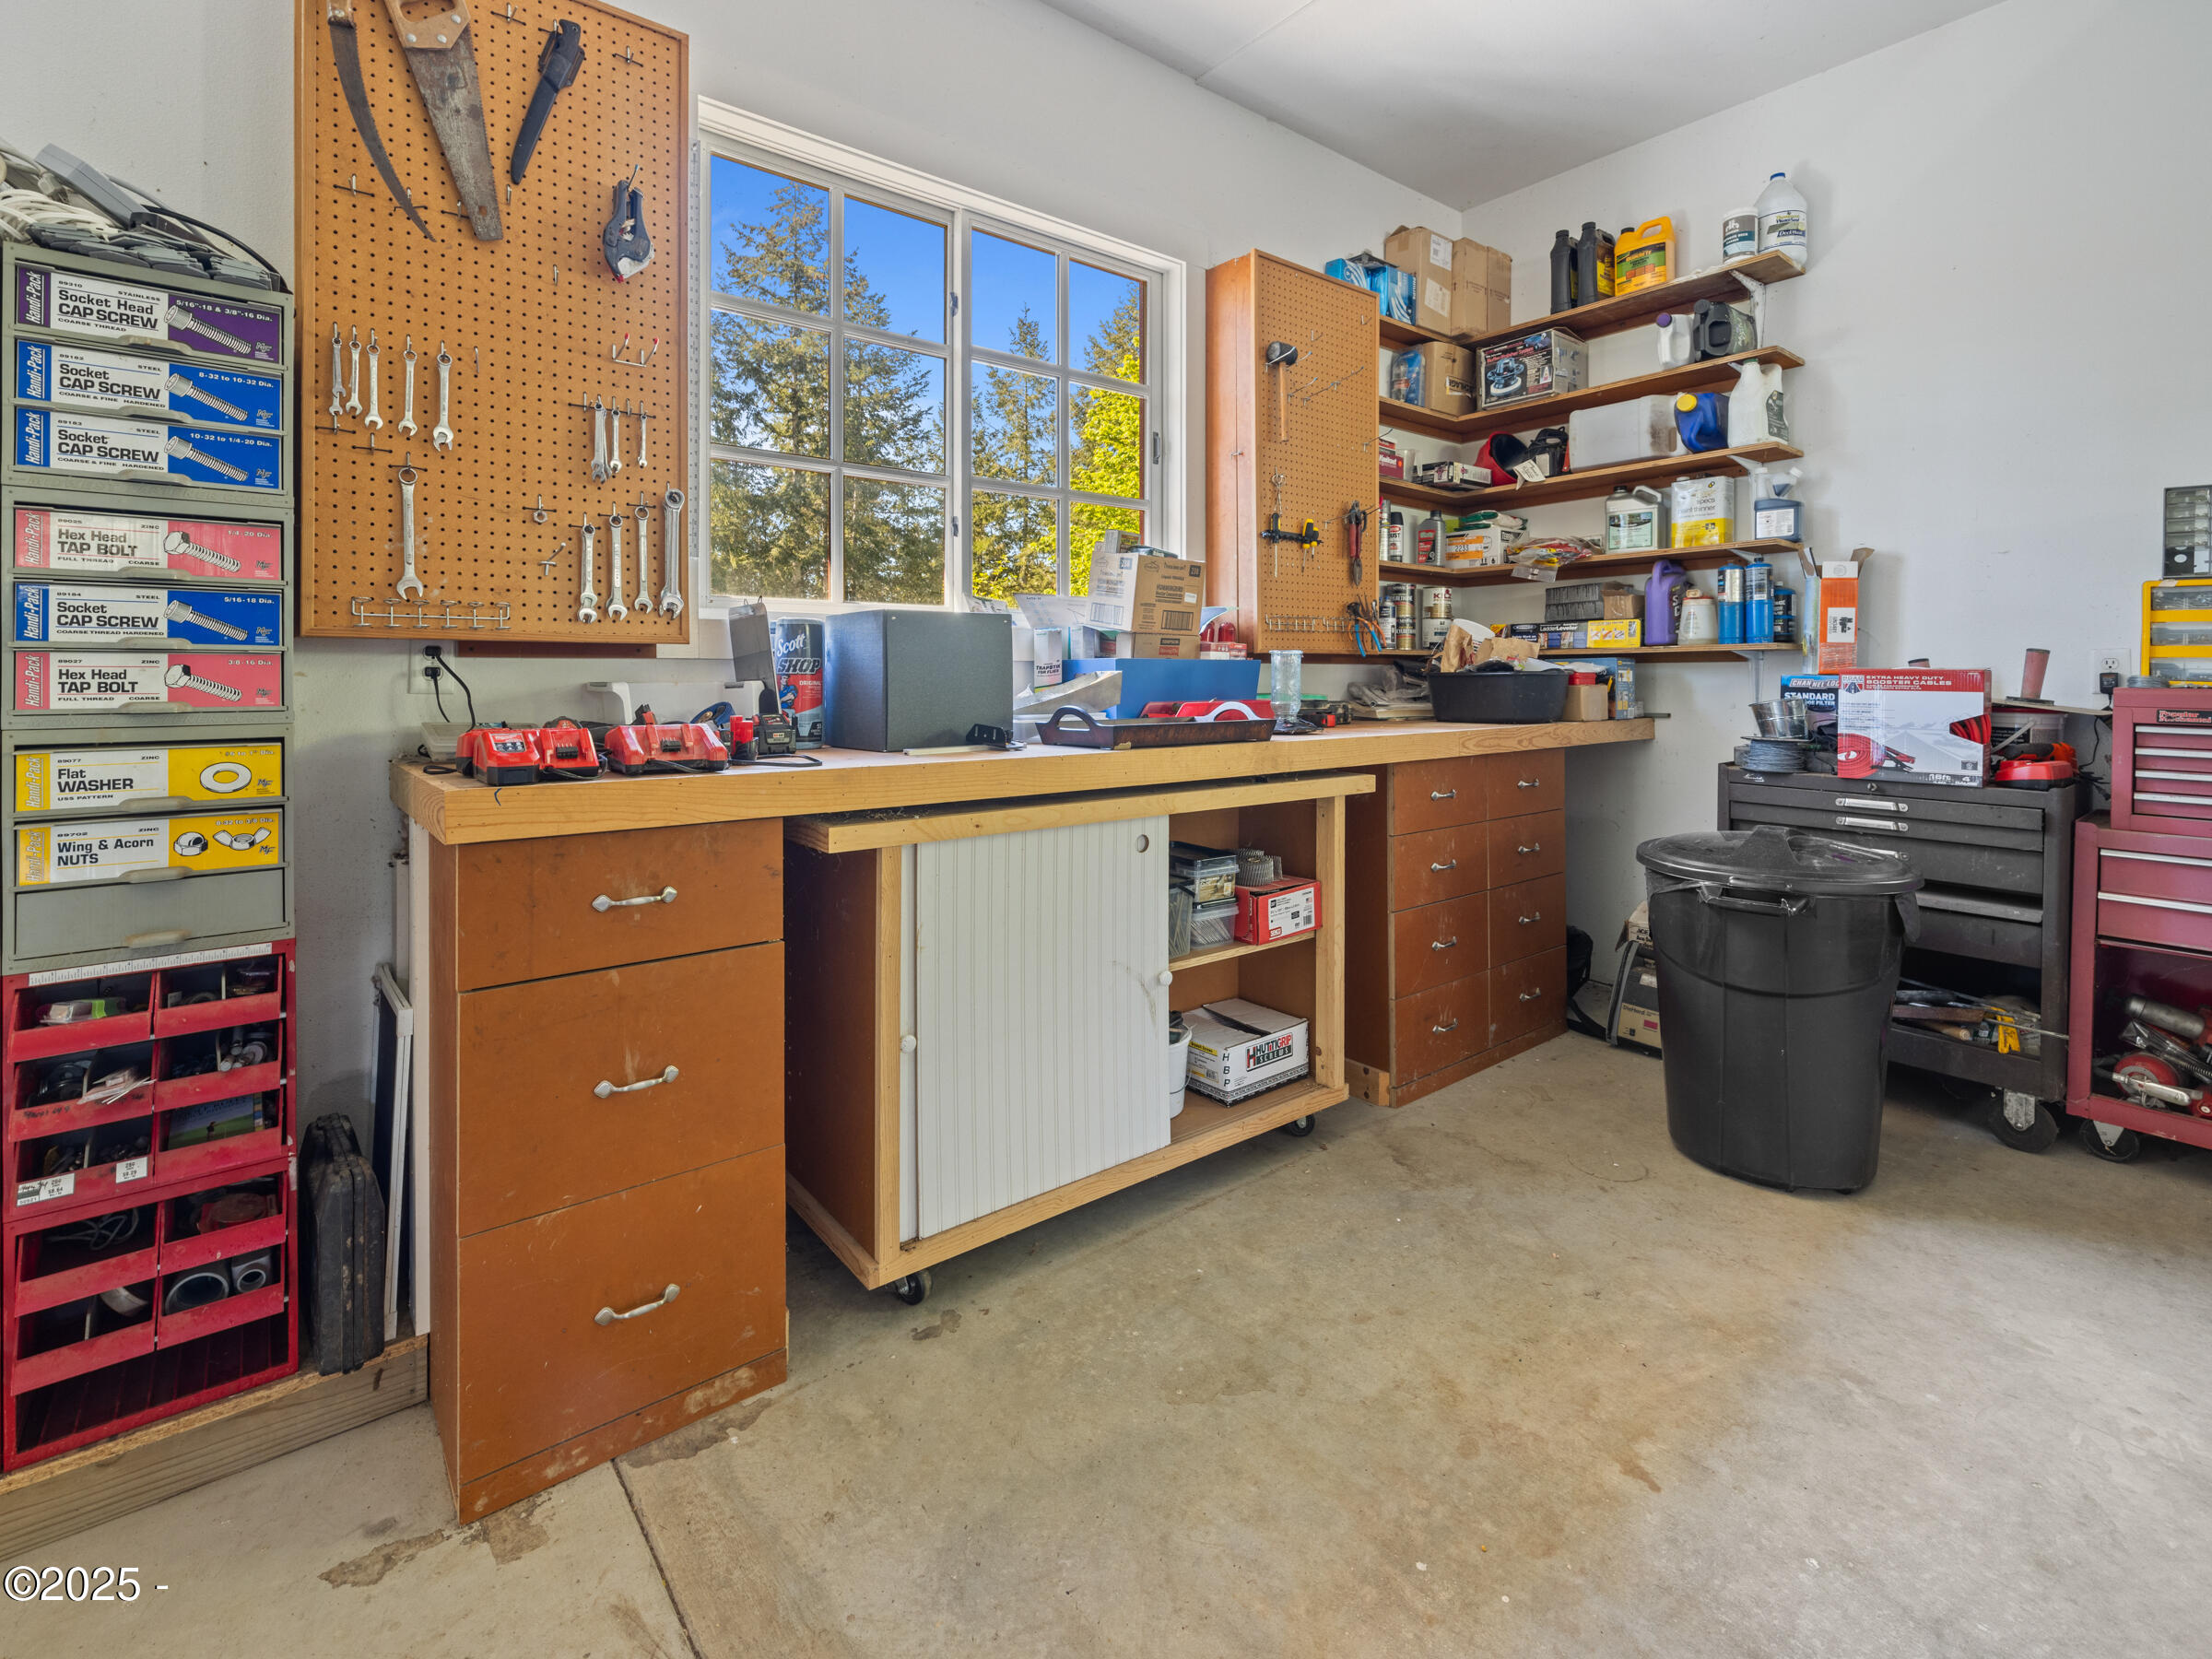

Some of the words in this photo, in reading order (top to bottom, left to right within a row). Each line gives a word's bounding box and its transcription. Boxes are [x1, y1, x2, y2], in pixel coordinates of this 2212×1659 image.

[25, 271, 41, 324] Handi-Pack
[59, 289, 112, 308] Socket
[117, 300, 154, 315] Head
[118, 290, 160, 301] STAINLESS
[59, 303, 94, 318] CAP
[96, 310, 159, 329] SCREW
[256, 313, 273, 322] Dia.
[58, 317, 92, 327] COARSE
[95, 324, 126, 332] THREAD
[27, 345, 42, 399] Handi-Pack
[59, 363, 110, 381] Socket
[137, 364, 162, 372] STEEL
[59, 377, 95, 392] CAP
[99, 382, 160, 400] SCREW
[233, 377, 256, 385] 10-32
[258, 380, 274, 388] Dia.
[59, 391, 91, 400] COARSE
[124, 399, 166, 408] HARDENED
[25, 411, 41, 465] Handi-Pack
[58, 429, 108, 445] Socket
[190, 432, 215, 441] 10-32
[229, 437, 255, 445] 1/4-20
[58, 442, 94, 456] CAP
[97, 445, 159, 462] SCREW
[57, 456, 90, 465] COARSE
[122, 463, 165, 471] HARDENED
[25, 512, 41, 565] Handi-Pack
[58, 528, 86, 541] Hex
[91, 531, 127, 543] Head
[57, 541, 91, 554] TAP
[97, 543, 137, 557] BOLT
[24, 586, 40, 639] Handi-Pack
[57, 601, 108, 614] Socket
[56, 615, 92, 628] CAP
[96, 616, 159, 629] SCREW
[777, 633, 806, 657] Scott
[58, 669, 86, 680] Hex
[91, 669, 127, 680] Head
[777, 658, 821, 675] SHOP
[25, 654, 40, 707] Handi-Pack
[58, 682, 91, 693] TAP
[97, 682, 138, 693] BOLT
[1784, 692, 1835, 700] STANDARD
[25, 757, 41, 808] Handi-Pack
[57, 769, 87, 780] Flat
[57, 778, 134, 793] WASHER
[57, 841, 93, 854] Wing
[98, 839, 109, 851] &
[113, 838, 154, 849] Acorn
[57, 854, 99, 866] NUTS
